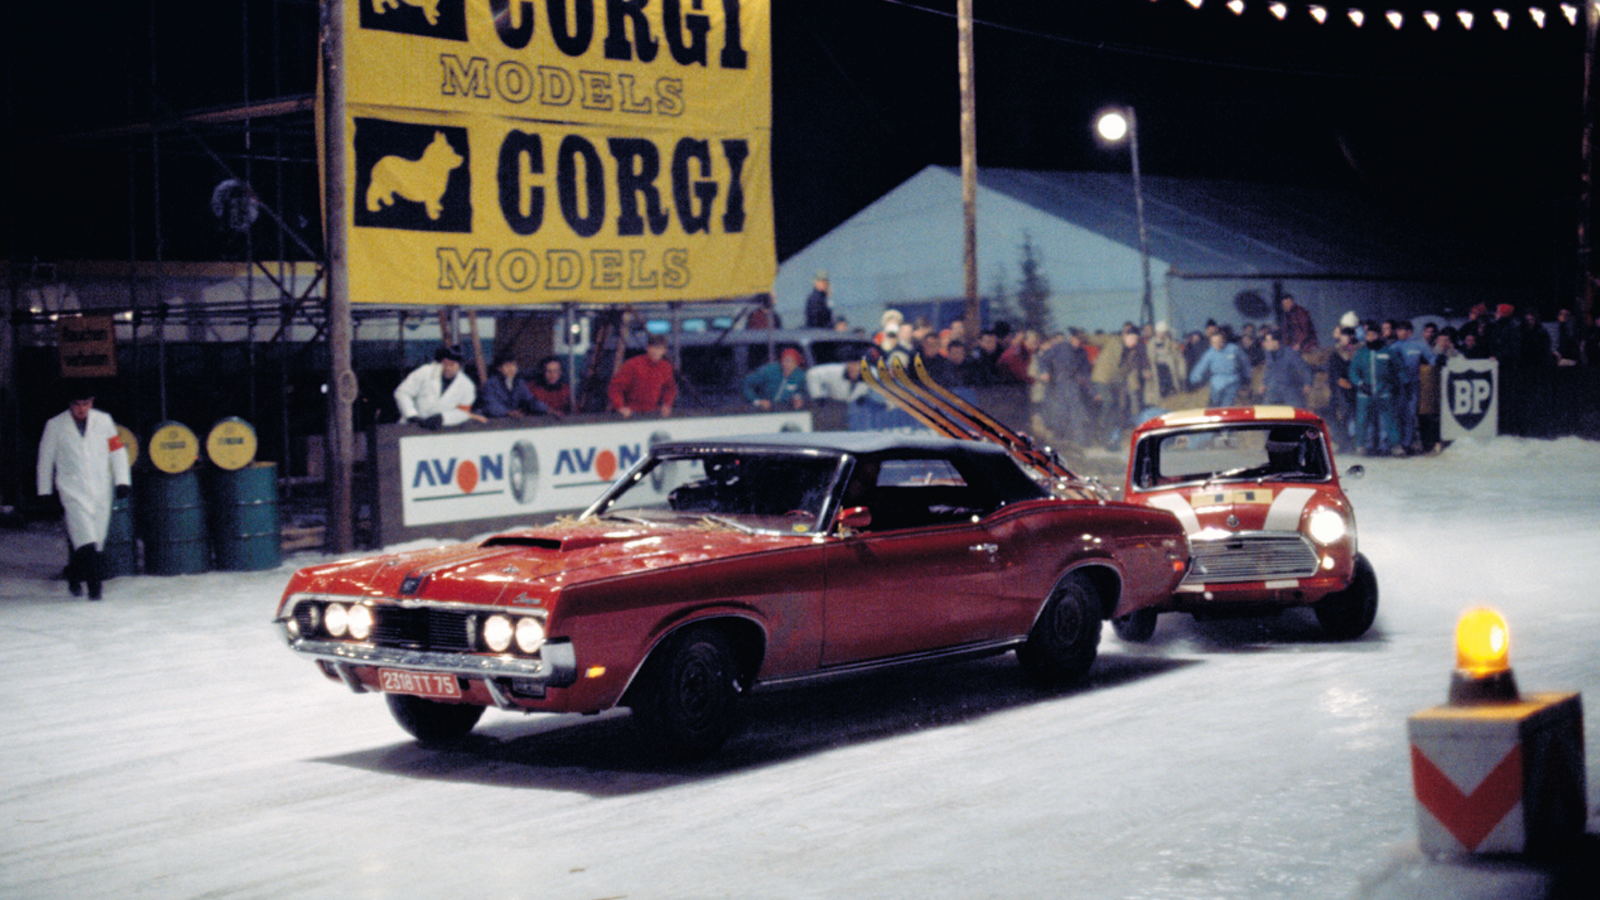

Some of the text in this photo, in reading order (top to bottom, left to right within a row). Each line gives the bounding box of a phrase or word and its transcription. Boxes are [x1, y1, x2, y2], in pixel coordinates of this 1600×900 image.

[440, 54, 685, 116] MODELS
[496, 128, 750, 237] CORGI
[436, 247, 690, 291] MODELS
[1453, 379, 1490, 414] BP
[412, 454, 504, 494] AVON
[553, 444, 640, 481] AVON
[383, 672, 454, 694] 2318 TT 75
